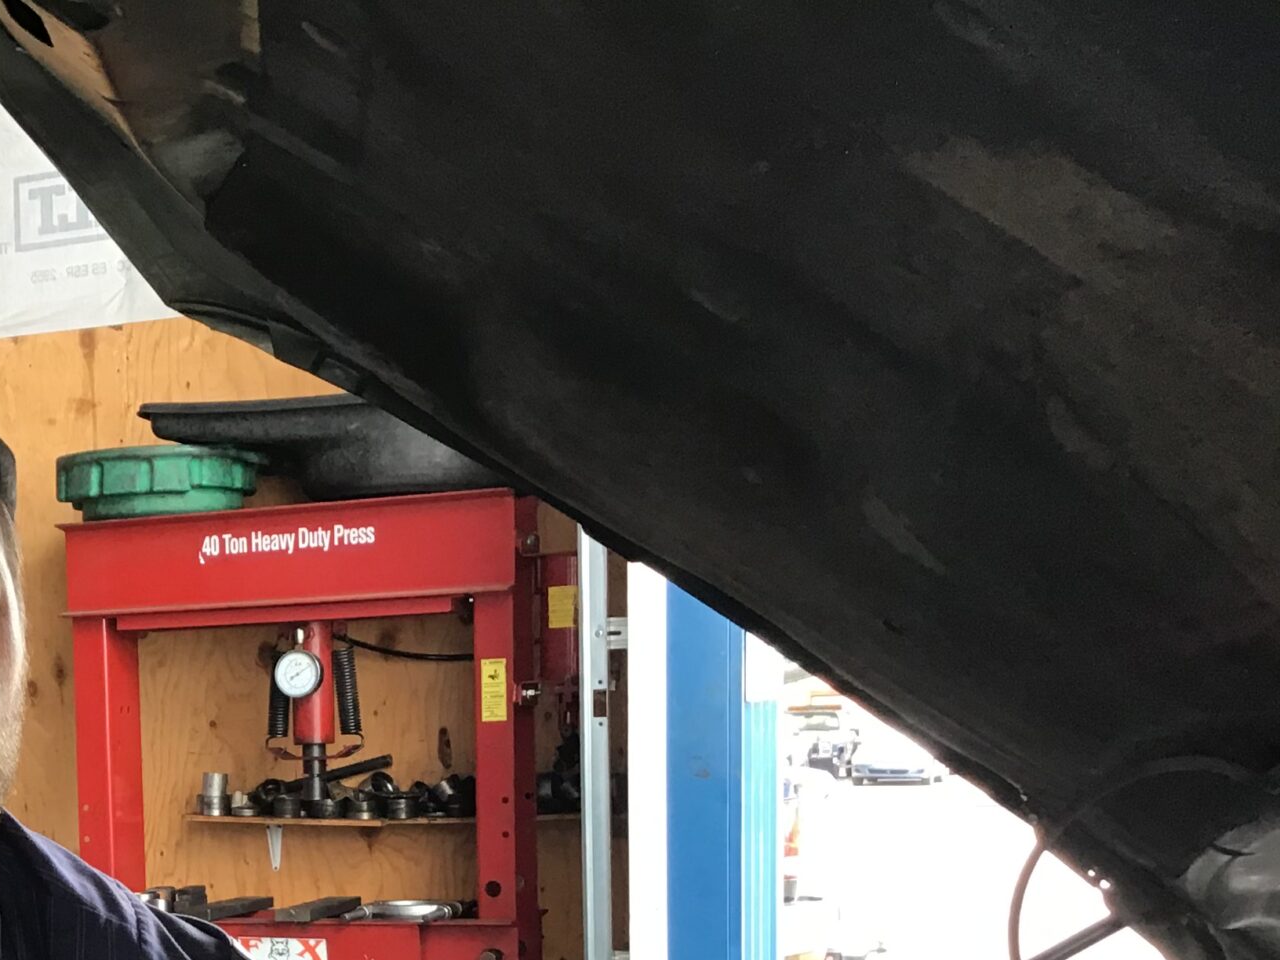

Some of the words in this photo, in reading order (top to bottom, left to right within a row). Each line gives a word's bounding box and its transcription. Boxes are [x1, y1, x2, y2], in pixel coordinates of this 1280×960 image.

[202, 535, 220, 557] 40
[222, 533, 248, 555] Ton
[251, 530, 295, 555] Heavy
[298, 526, 331, 552] Duty
[333, 524, 376, 546] Press
